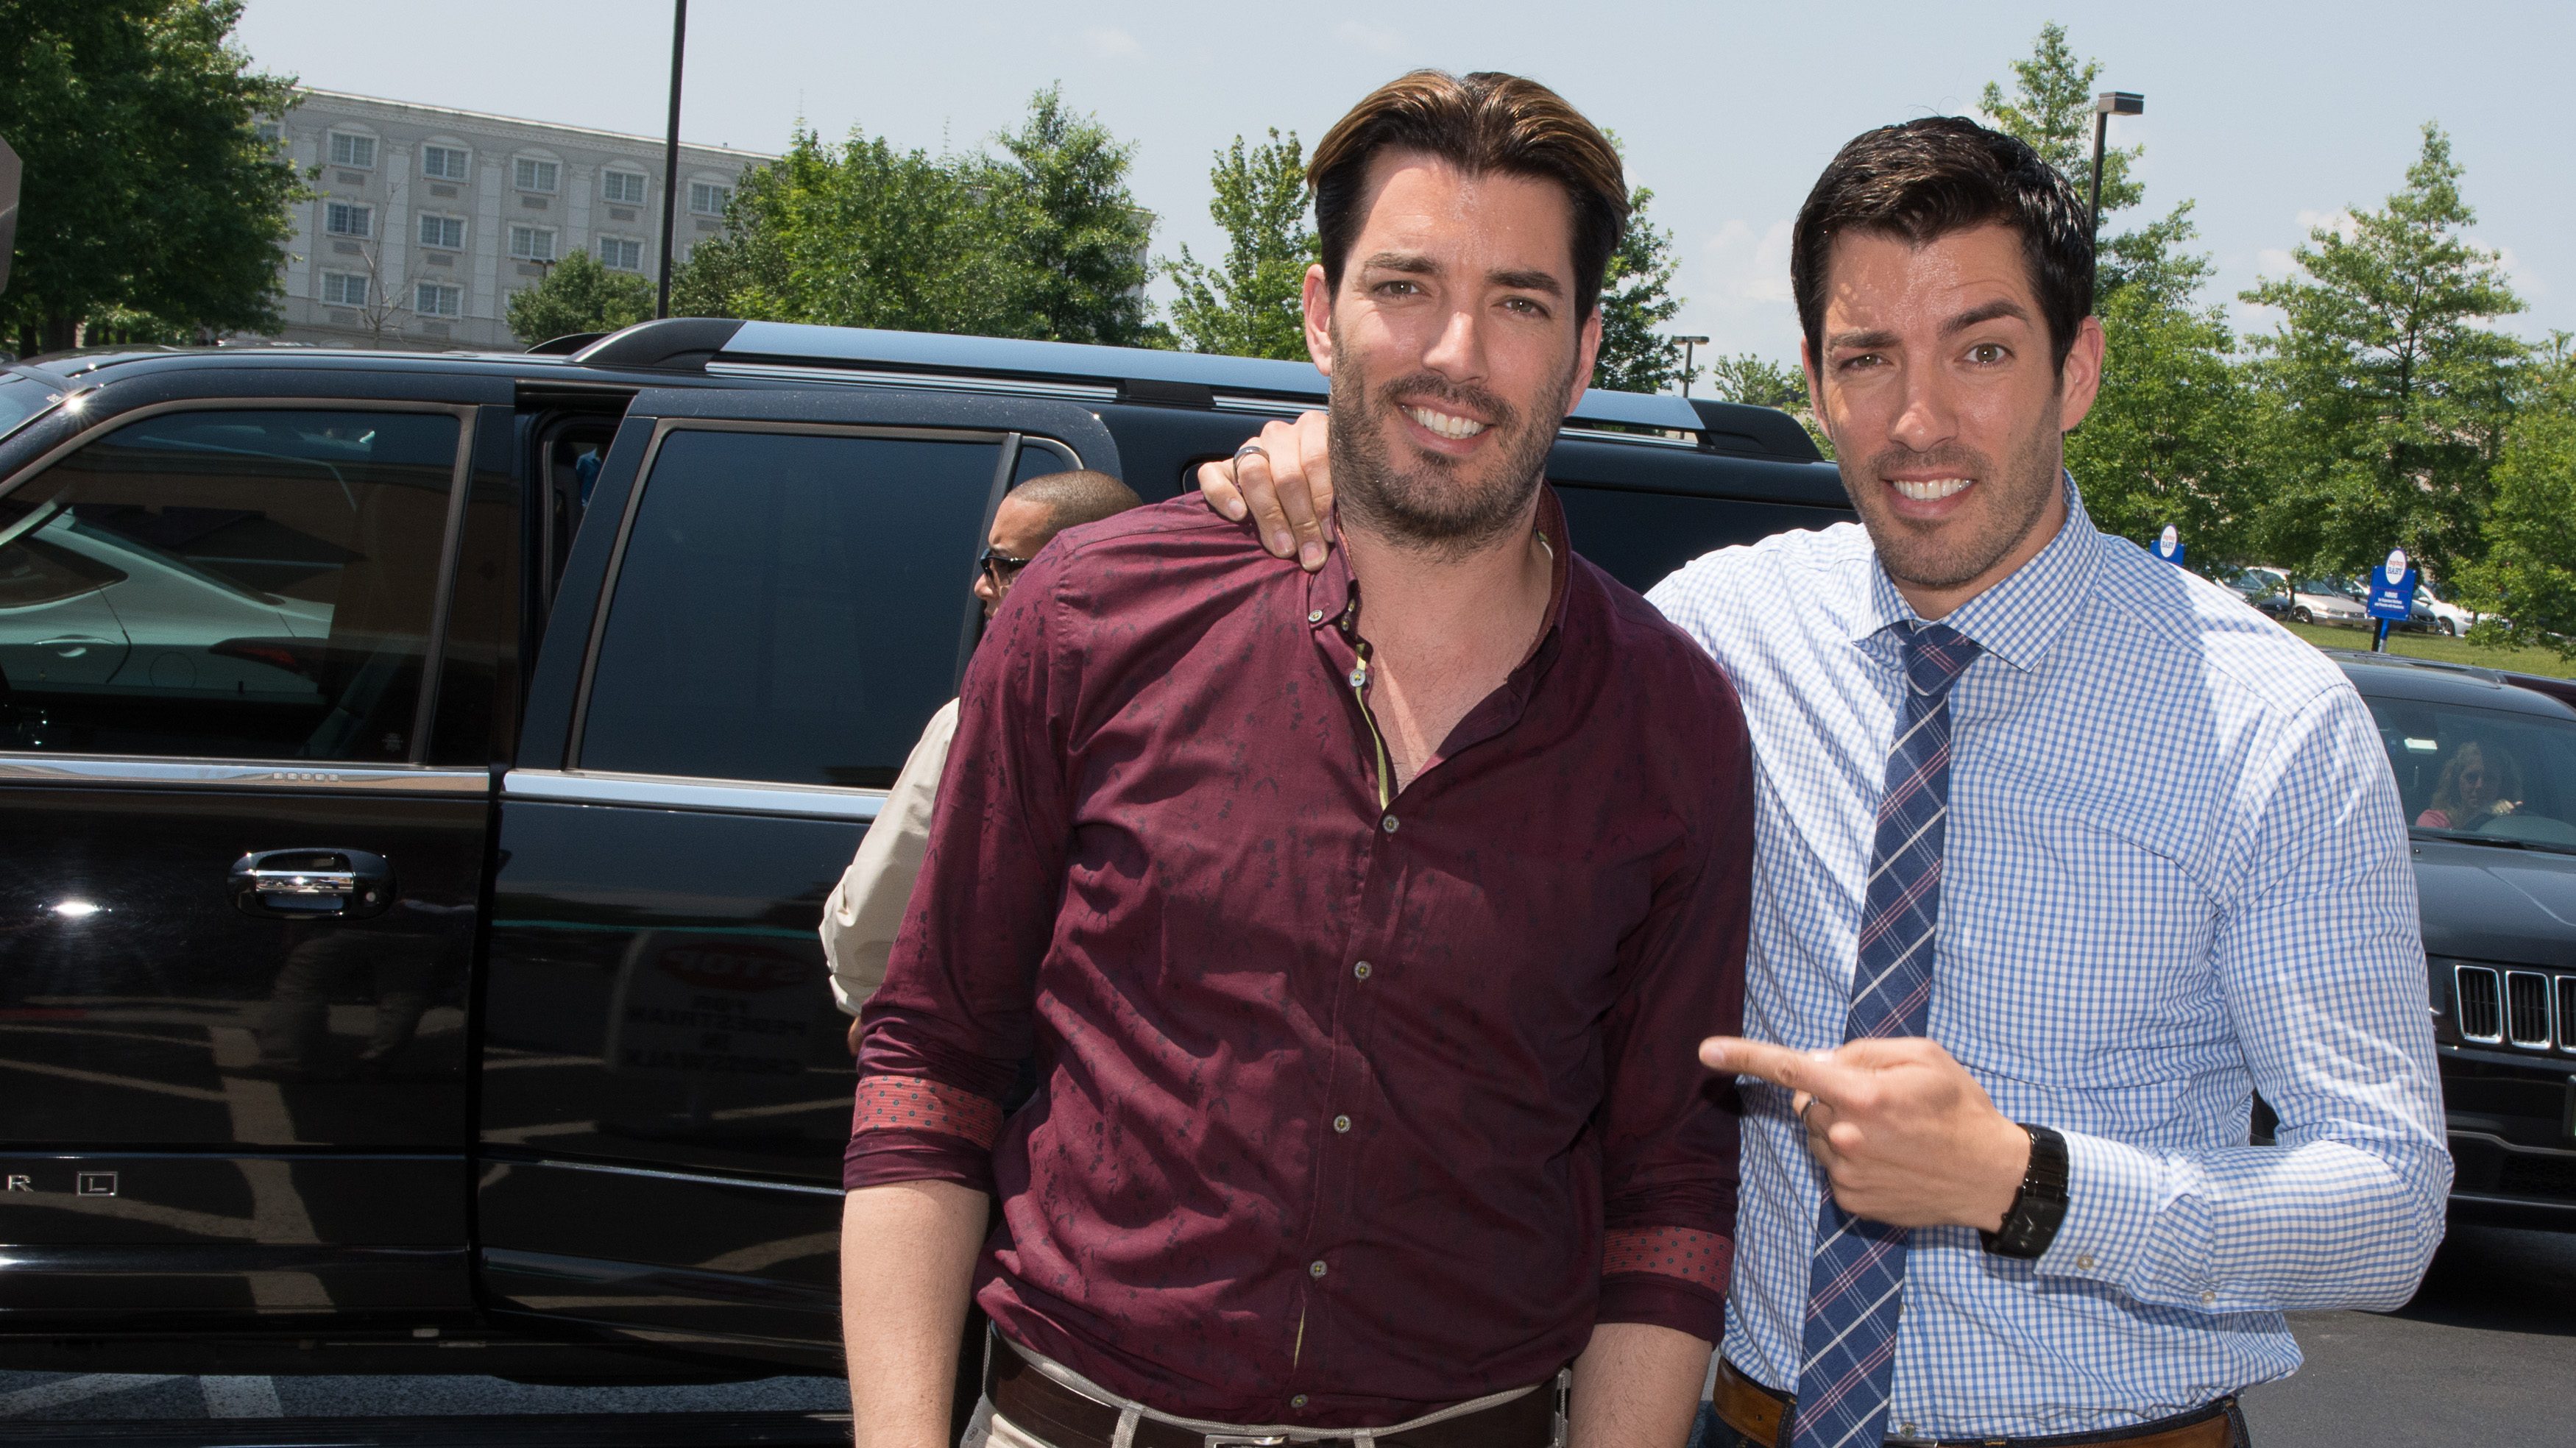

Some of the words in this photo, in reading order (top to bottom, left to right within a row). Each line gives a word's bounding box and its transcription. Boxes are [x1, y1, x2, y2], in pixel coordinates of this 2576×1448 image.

[2162, 541, 2175, 549] BABY
[2387, 567, 2403, 575] BABY
[8, 1175, 34, 1192] R
[88, 1177, 107, 1192] L
